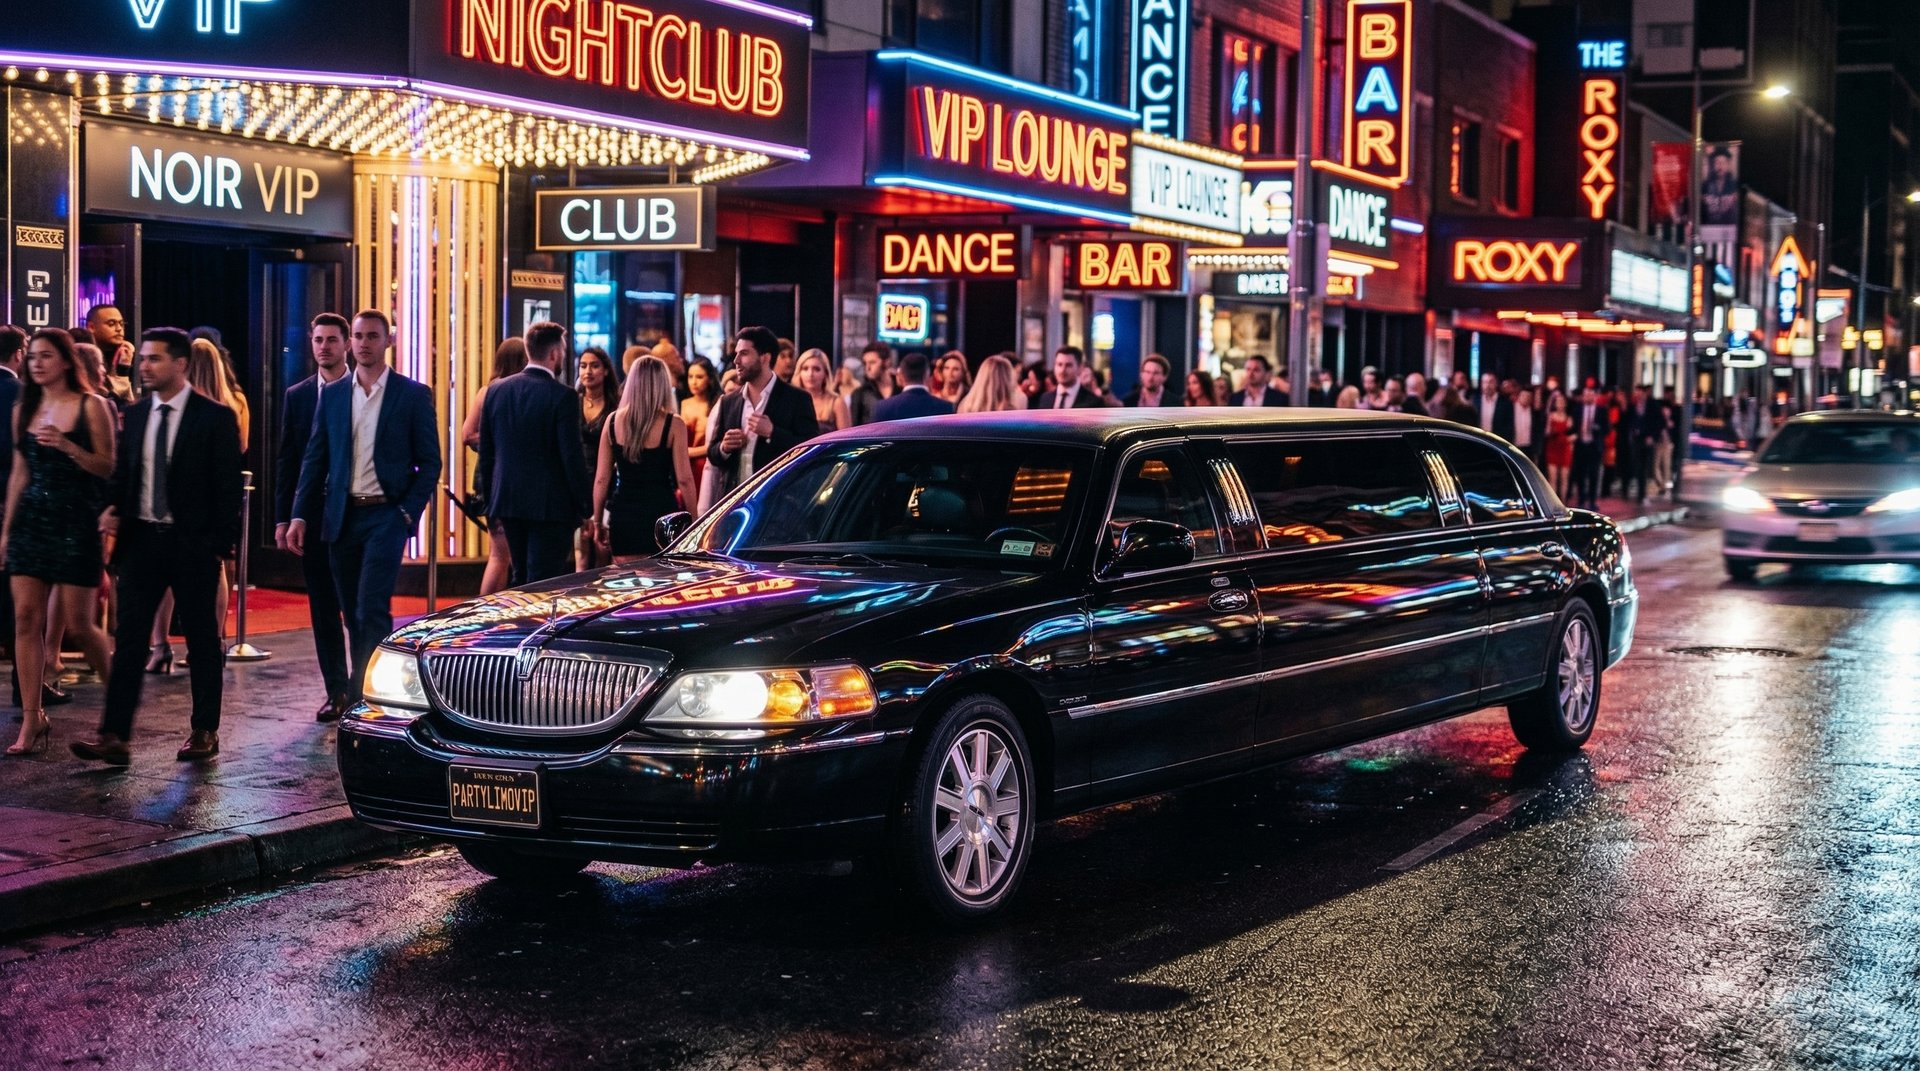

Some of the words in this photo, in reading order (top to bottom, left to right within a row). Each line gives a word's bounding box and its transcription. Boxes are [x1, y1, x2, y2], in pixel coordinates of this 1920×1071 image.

[460, 0, 784, 117] NIGHTCLUB
[1578, 41, 1625, 68] THE
[1355, 13, 1398, 166] BAR
[924, 86, 985, 164] VIP
[992, 104, 1128, 195] LOUNGE
[1580, 79, 1619, 219] ROXY
[130, 145, 243, 210] NOIR
[254, 162, 320, 216] VIP
[1149, 160, 1172, 207] VIP
[1176, 166, 1229, 218] LOUNGE
[560, 198, 678, 242] CLUB
[1329, 184, 1387, 247] DANCE
[883, 232, 1015, 274] DANCE
[1079, 242, 1173, 287] BAR
[1454, 240, 1578, 282] ROXY
[452, 782, 535, 813] PARTYLIMOVIP
